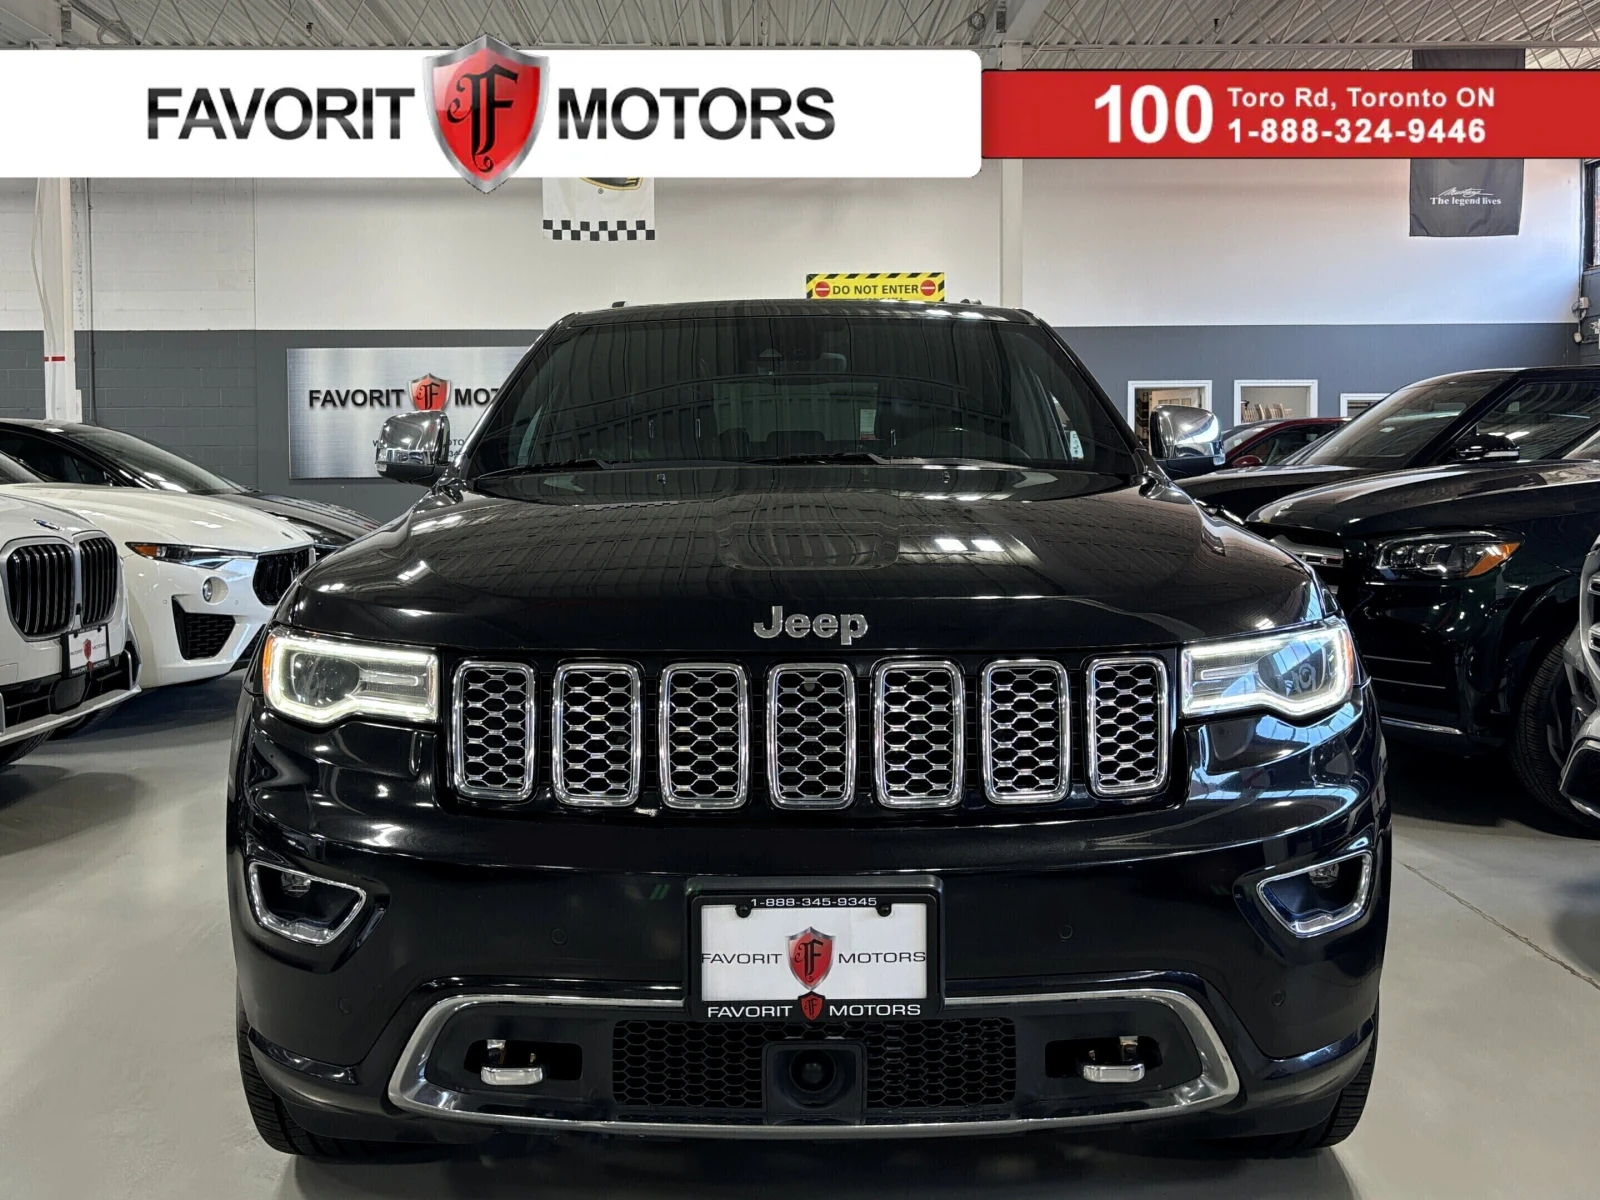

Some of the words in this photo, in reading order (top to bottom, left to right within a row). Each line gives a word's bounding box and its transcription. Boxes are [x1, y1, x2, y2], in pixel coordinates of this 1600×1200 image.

[1430, 197, 1449, 205] The
[1451, 197, 1480, 206] legend
[1482, 197, 1502, 205] lives
[832, 285, 850, 295] DO
[854, 285, 878, 295] NOT
[881, 284, 919, 294] ENTER
[309, 388, 404, 408] FAVORIT
[753, 605, 868, 645] Jeep
[751, 897, 877, 907] 1-888-345-9345
[701, 952, 783, 965] FAVORIT
[838, 951, 926, 964] MOTORS
[707, 1005, 793, 1018] FAVORIT
[829, 1004, 921, 1016] MOTORS
